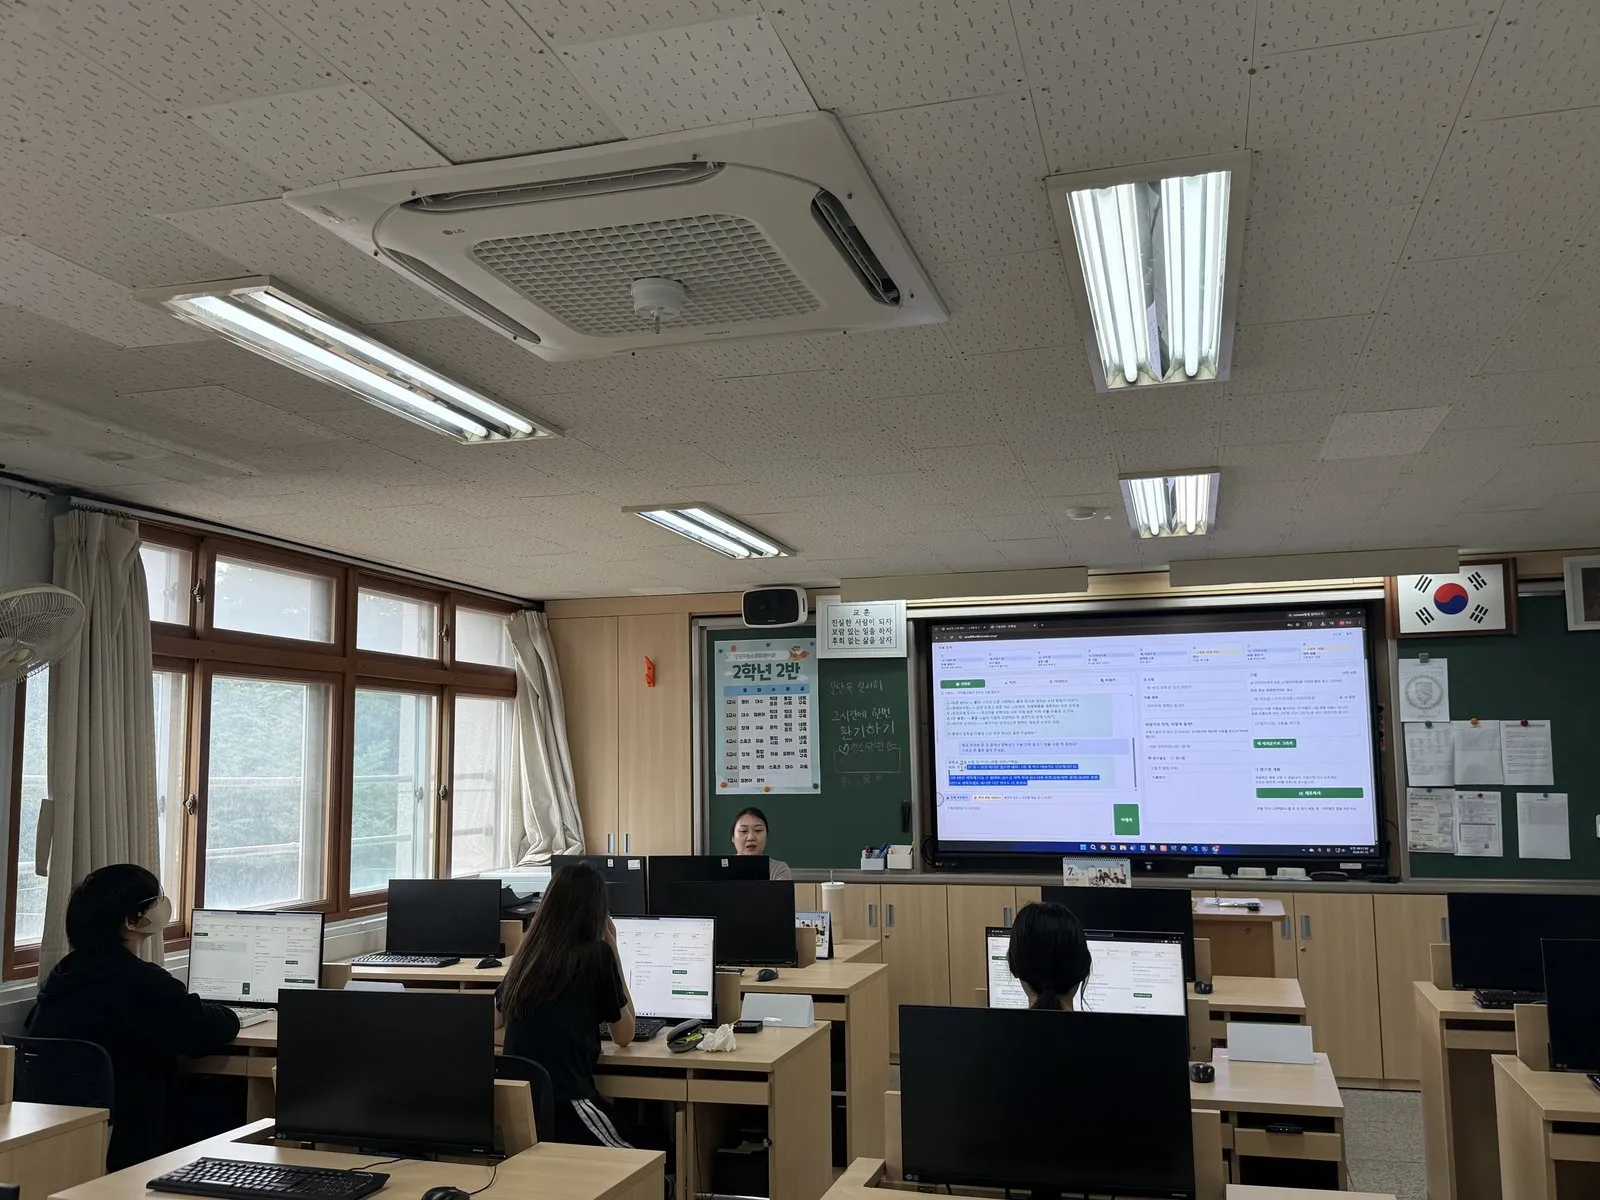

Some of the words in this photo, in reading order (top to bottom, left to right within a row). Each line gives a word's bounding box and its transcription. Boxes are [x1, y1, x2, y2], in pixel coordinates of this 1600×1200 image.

[831, 618, 852, 627] 진실한
[855, 618, 875, 626] 사람이
[878, 617, 892, 626] 되자
[831, 627, 845, 636] 보람
[847, 627, 860, 635] 있는
[862, 627, 875, 635] 일을
[879, 627, 892, 635] 하자
[832, 637, 845, 645] 후회
[847, 636, 860, 645] 없는
[862, 636, 876, 645] 삶을
[879, 636, 892, 644] 살자
[732, 663, 771, 681] 2학년
[775, 662, 801, 680] 2반
[840, 721, 895, 741] 환기하기
